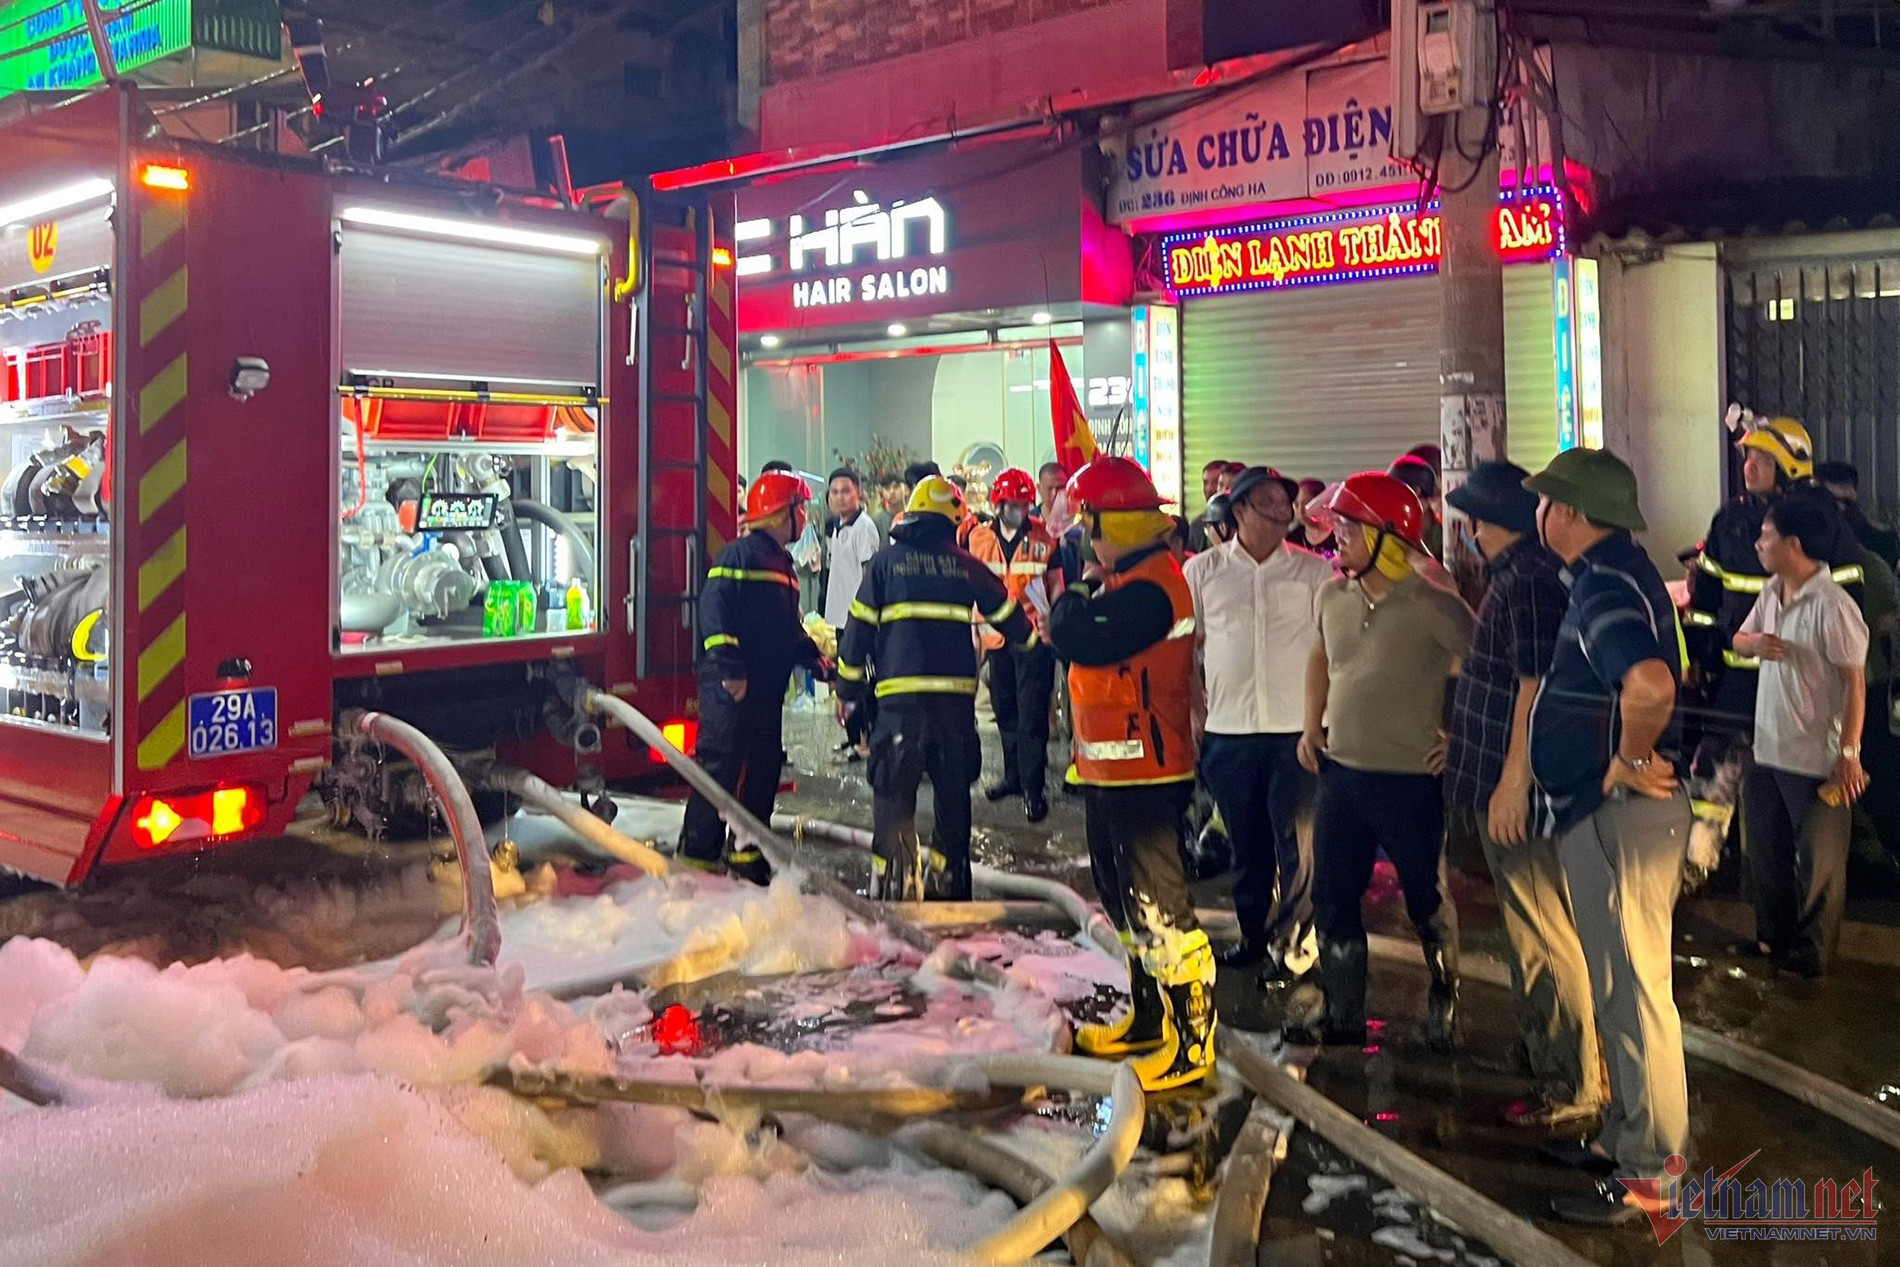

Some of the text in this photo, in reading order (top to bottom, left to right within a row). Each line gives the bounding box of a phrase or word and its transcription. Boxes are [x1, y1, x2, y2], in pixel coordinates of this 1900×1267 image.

[1197, 113, 1291, 171] CHỮA
[793, 266, 947, 308] HAIR SALON
[211, 692, 256, 723] 29A
[192, 718, 273, 754] 026.13
